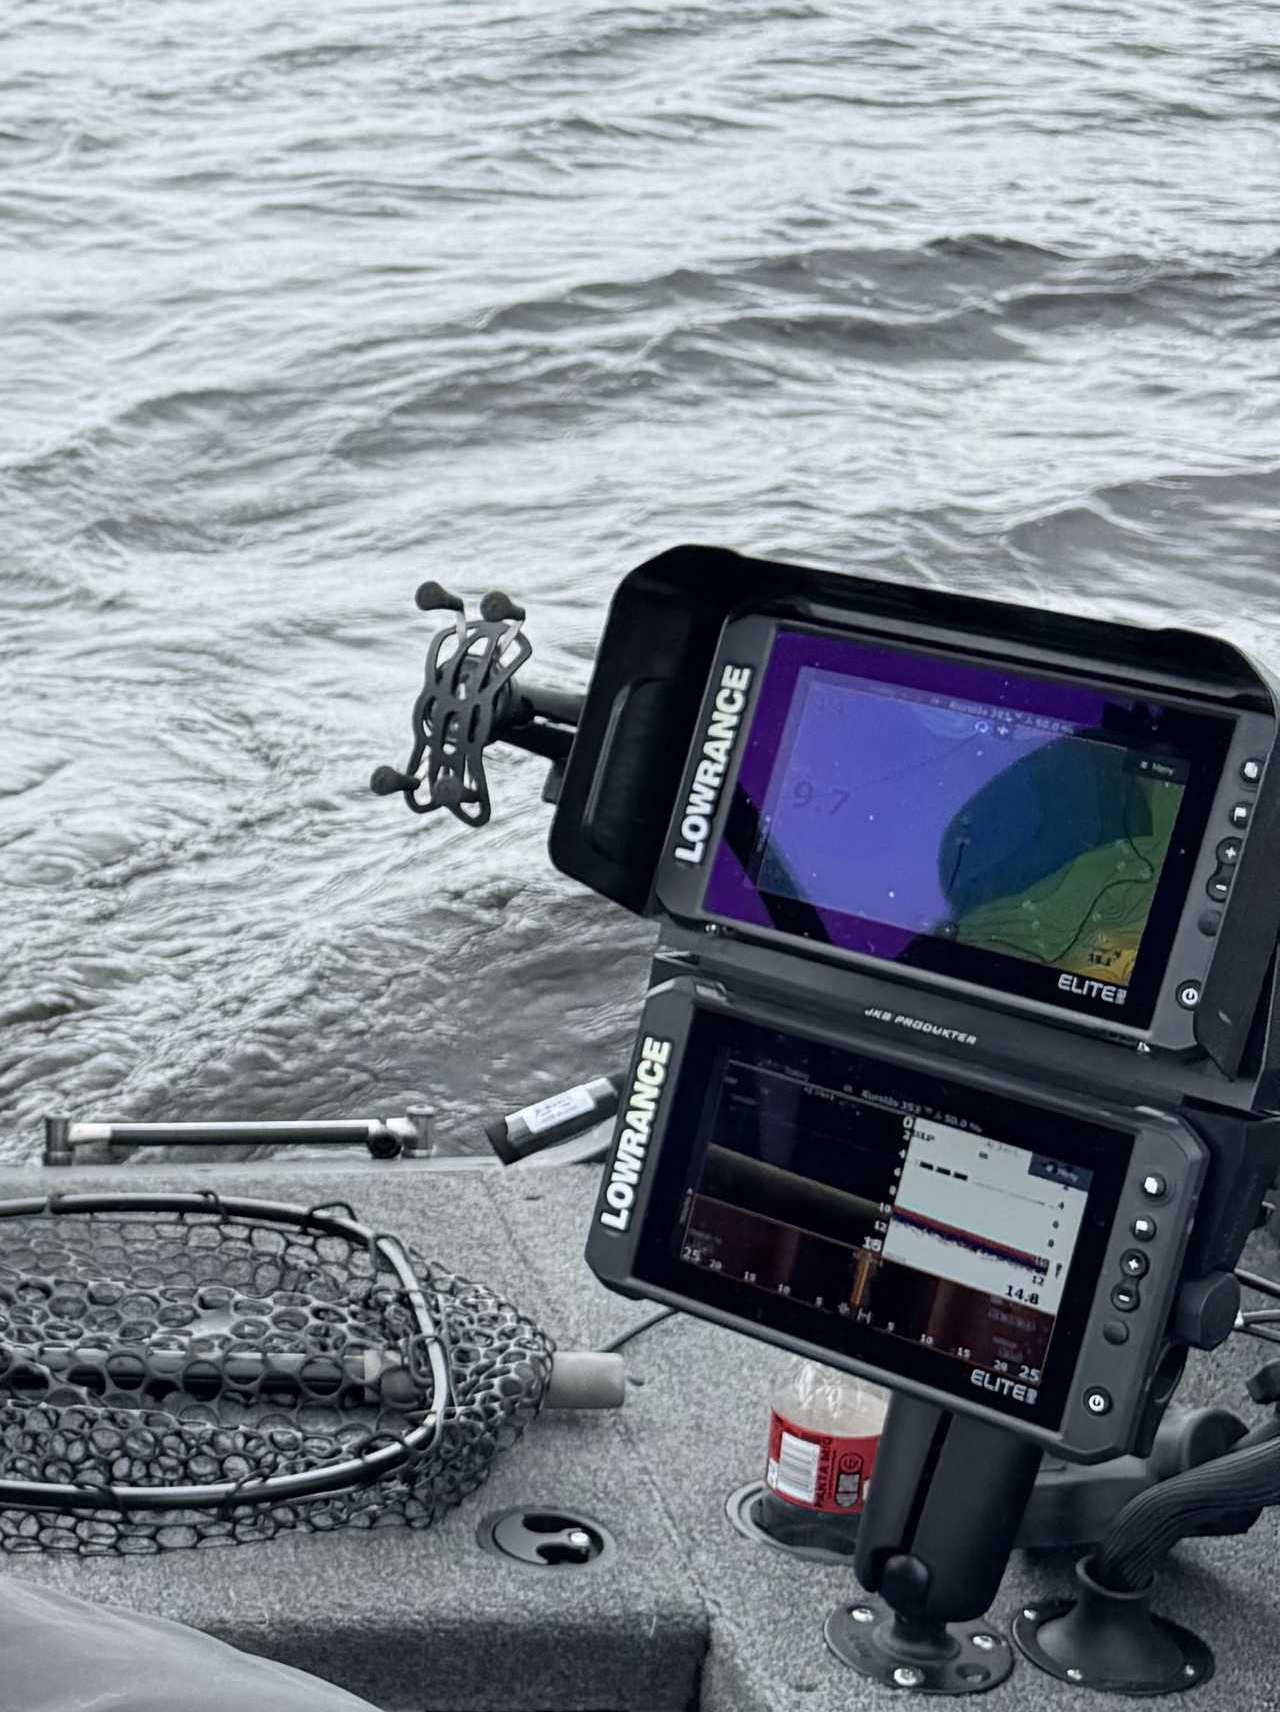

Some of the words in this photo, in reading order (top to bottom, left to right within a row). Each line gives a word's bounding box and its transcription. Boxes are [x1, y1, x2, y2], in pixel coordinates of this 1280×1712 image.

[675, 665, 751, 864] LOWRANCE
[1058, 973, 1118, 1003] ELITE
[601, 1037, 671, 1231] LOWRANCE
[1006, 1285, 1040, 1306] 14.8
[971, 1369, 1026, 1402] ELITE
[1018, 1365, 1041, 1383] 25
